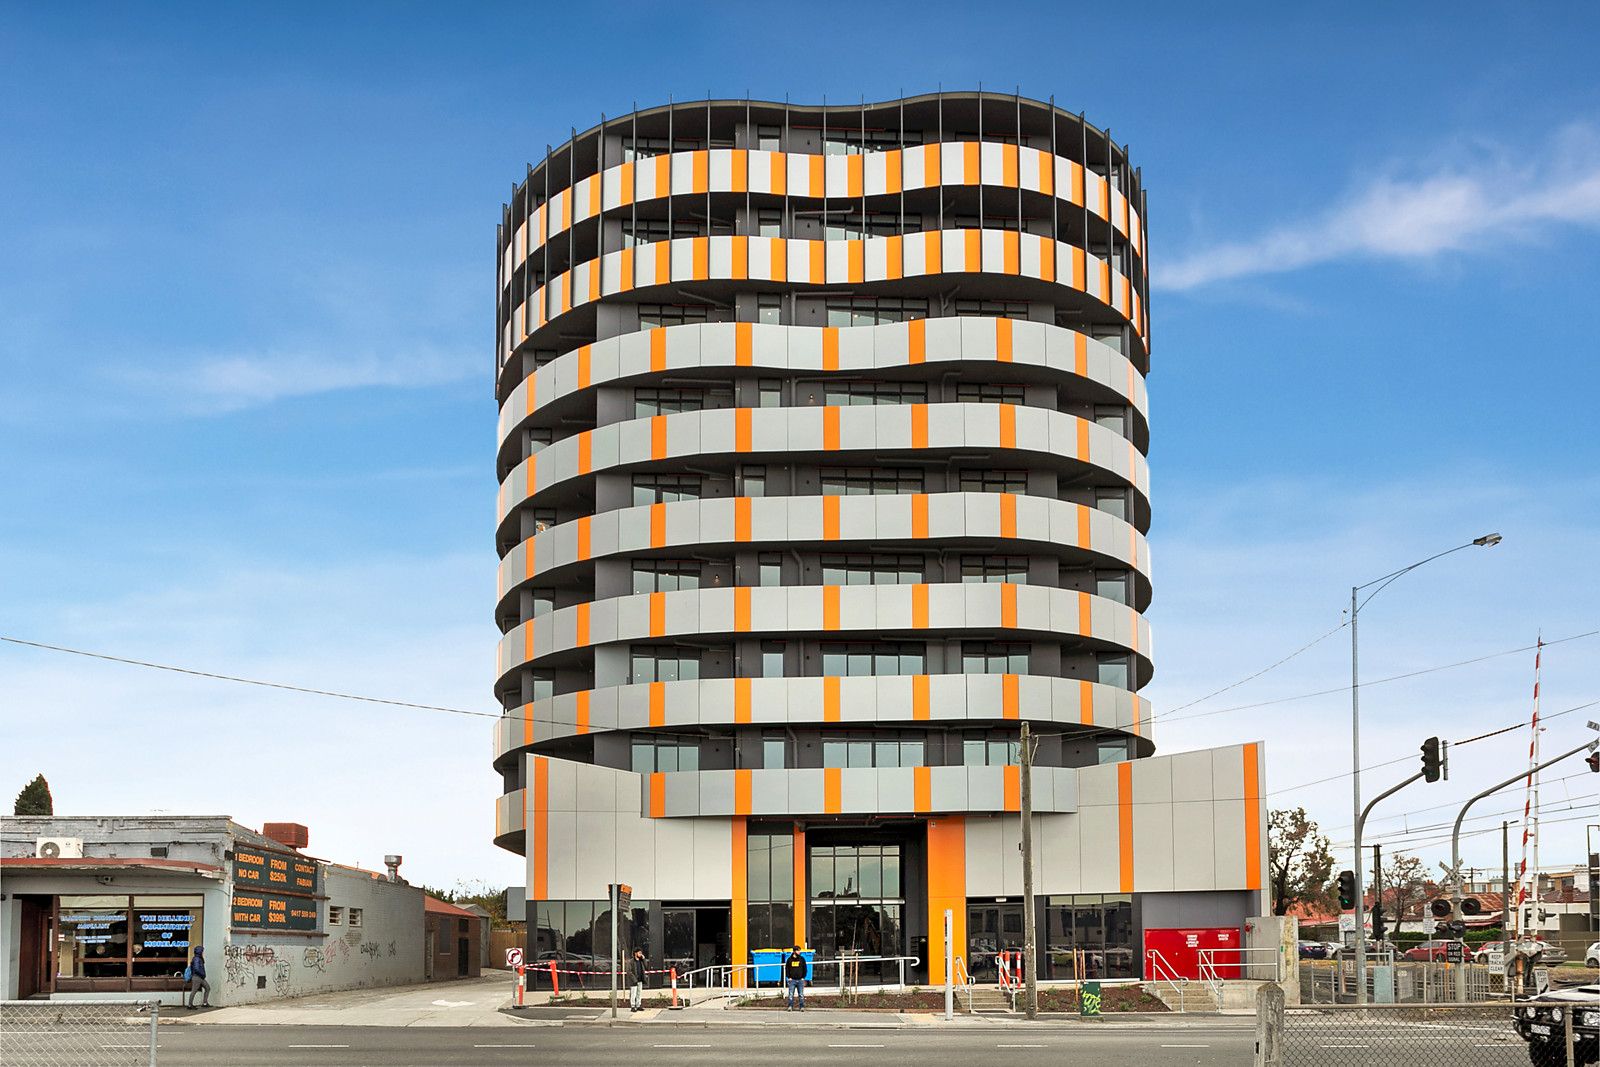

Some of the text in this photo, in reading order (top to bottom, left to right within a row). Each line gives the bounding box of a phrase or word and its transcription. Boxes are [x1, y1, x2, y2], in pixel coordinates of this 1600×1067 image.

[238, 853, 264, 865] BEDROOM
[270, 859, 288, 871] FROM
[238, 868, 260, 880] NO CAR
[294, 863, 316, 875] CONTACT
[237, 897, 263, 908] BEDROOM
[269, 900, 286, 911] FROM
[233, 912, 261, 923] WITH CAR
